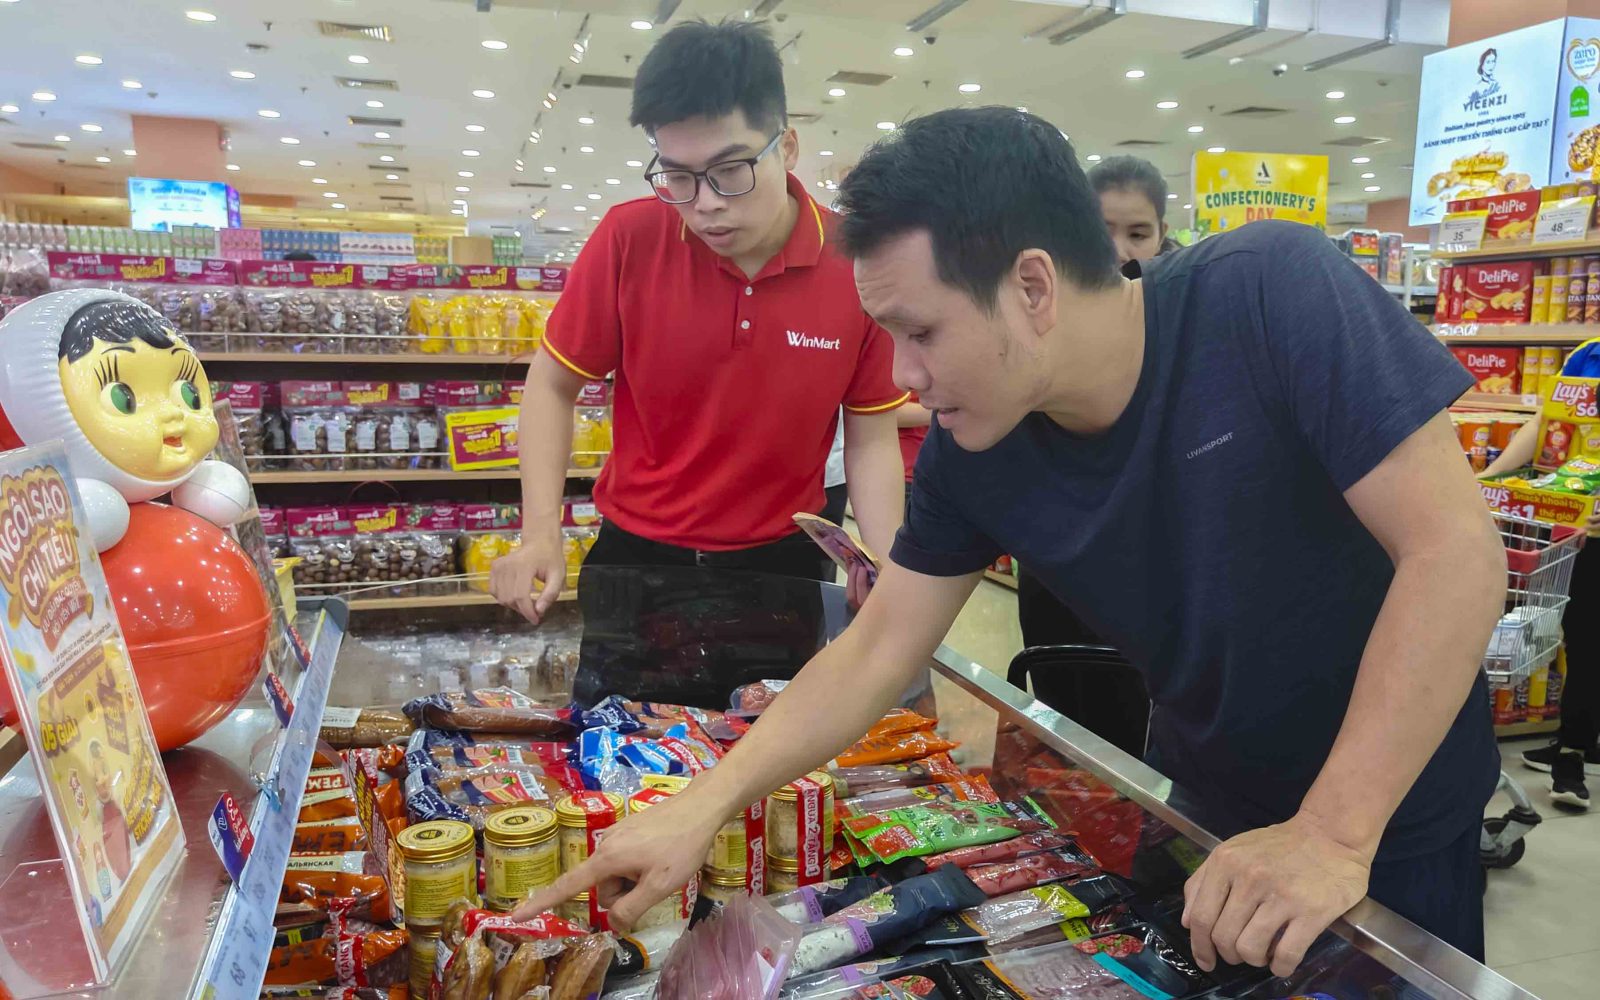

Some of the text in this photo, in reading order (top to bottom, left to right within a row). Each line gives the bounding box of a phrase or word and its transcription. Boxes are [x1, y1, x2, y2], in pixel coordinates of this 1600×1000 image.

[1463, 94, 1507, 112] VICENZI
[1206, 190, 1316, 212] CONFECTIONERY'S
[1488, 199, 1527, 215] DeliPie
[1246, 207, 1274, 223] DAY
[1551, 222, 1563, 233] 48
[1478, 269, 1519, 284] DeliPie
[786, 330, 840, 350] WinMart
[1467, 354, 1506, 368] DeliPie
[1552, 382, 1590, 405] Lay's
[1477, 483, 1510, 507] ay's
[1542, 496, 1568, 507] khoai
[1569, 500, 1584, 511] tây
[0, 484, 66, 576] NGÔI SAO
[23, 526, 73, 607] CHI TIÊU
